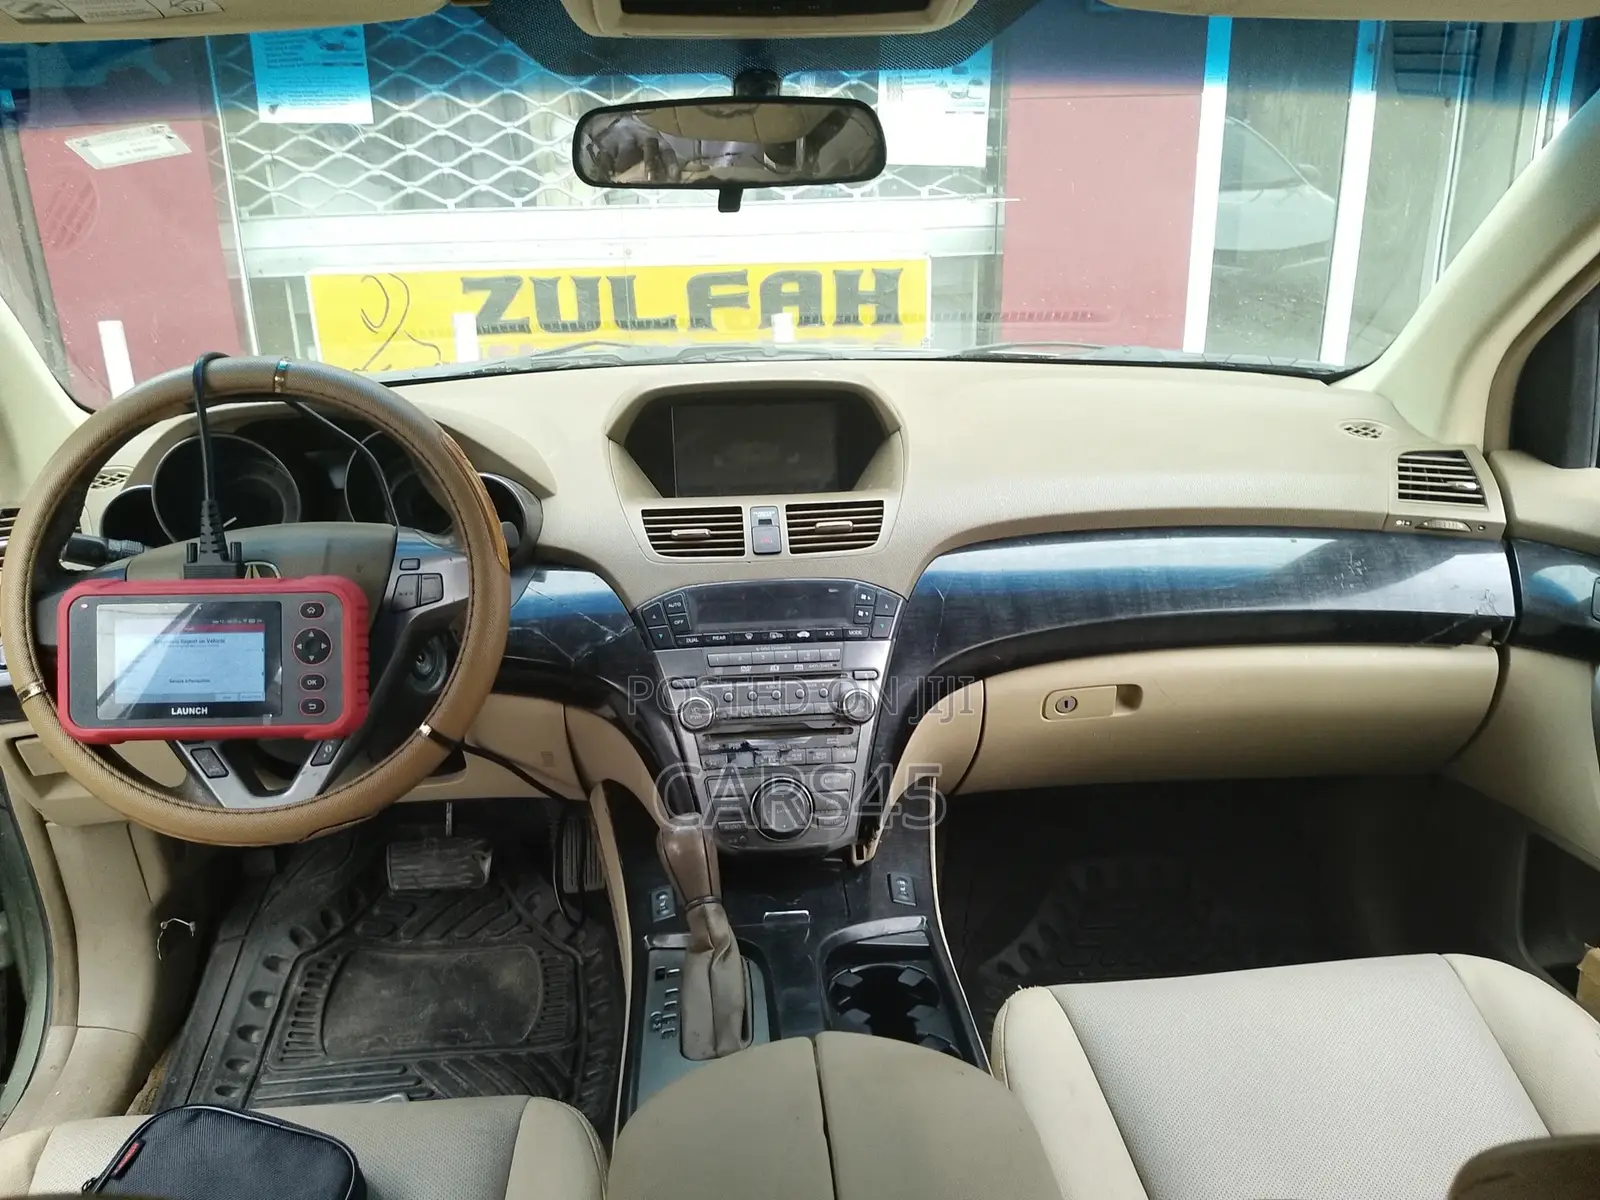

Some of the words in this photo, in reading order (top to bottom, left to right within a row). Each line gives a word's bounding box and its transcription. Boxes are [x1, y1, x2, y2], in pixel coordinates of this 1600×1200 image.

[461, 267, 904, 336] ZULFAH
[306, 678, 318, 686] OK
[170, 706, 209, 716] LAUNCH
